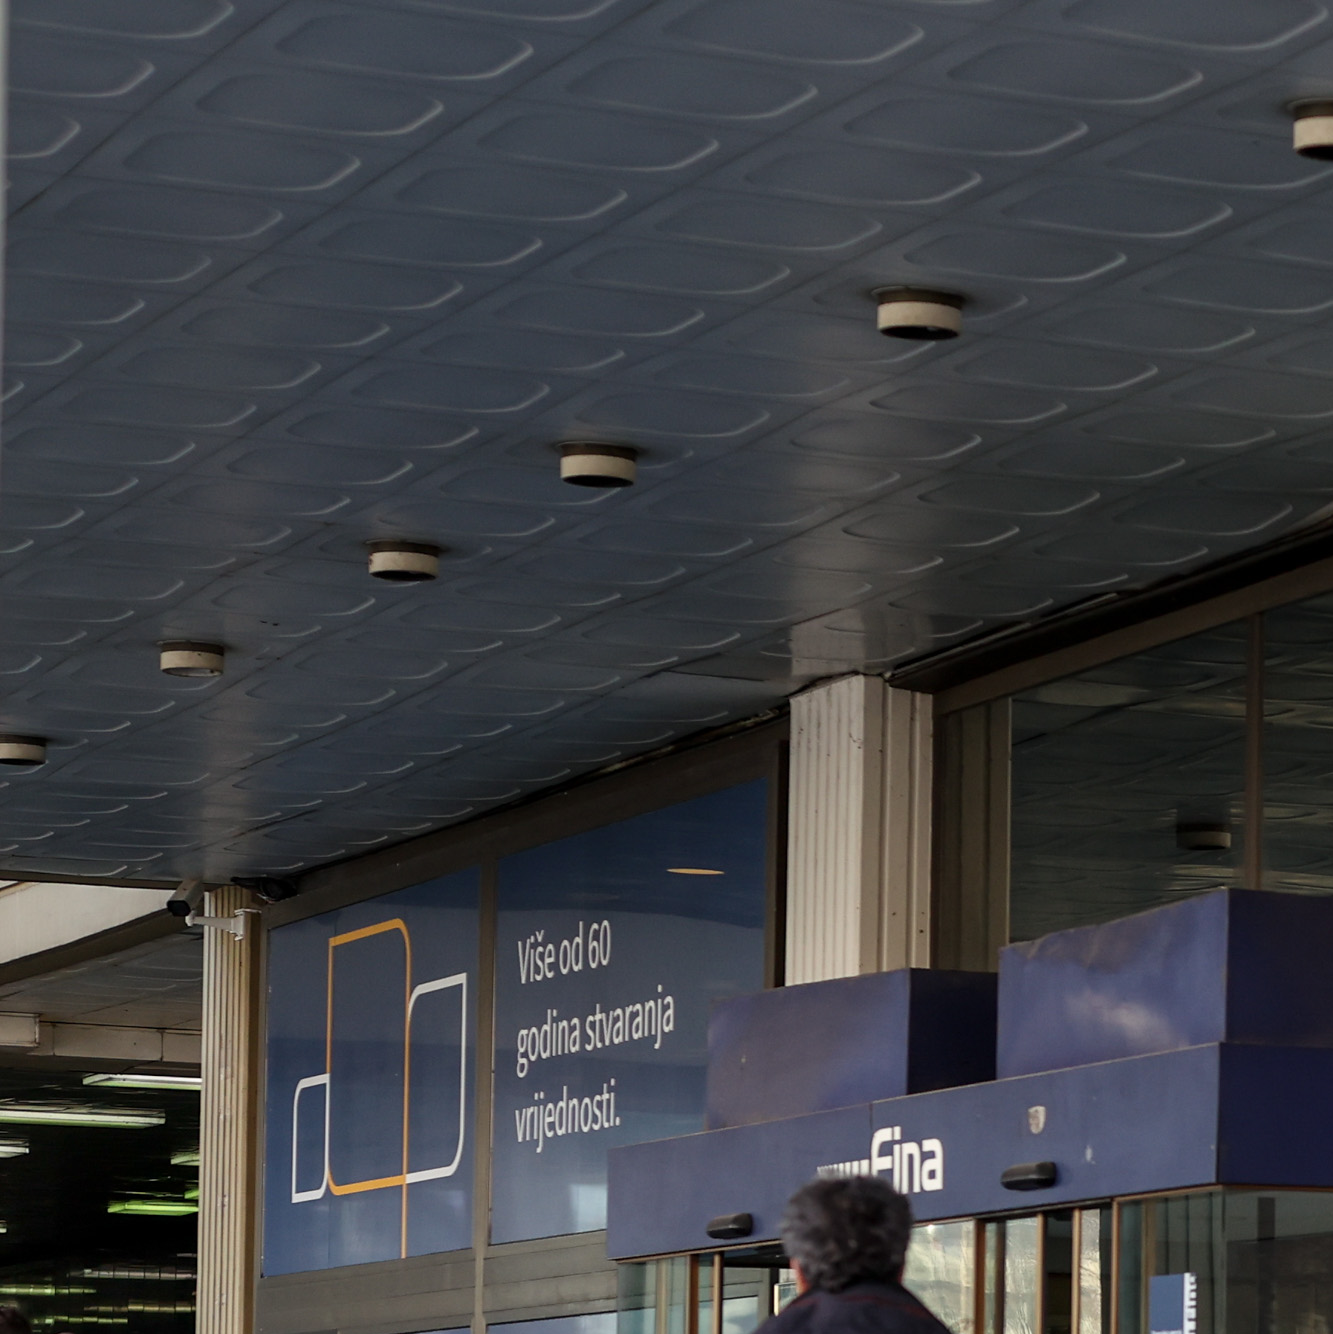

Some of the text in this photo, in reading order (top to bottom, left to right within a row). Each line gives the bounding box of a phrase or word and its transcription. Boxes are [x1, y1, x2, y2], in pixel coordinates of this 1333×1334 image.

[517, 919, 611, 984] Više od 60
[516, 984, 675, 1078] godina stvaranja
[515, 1078, 620, 1153] vrijednosti.
